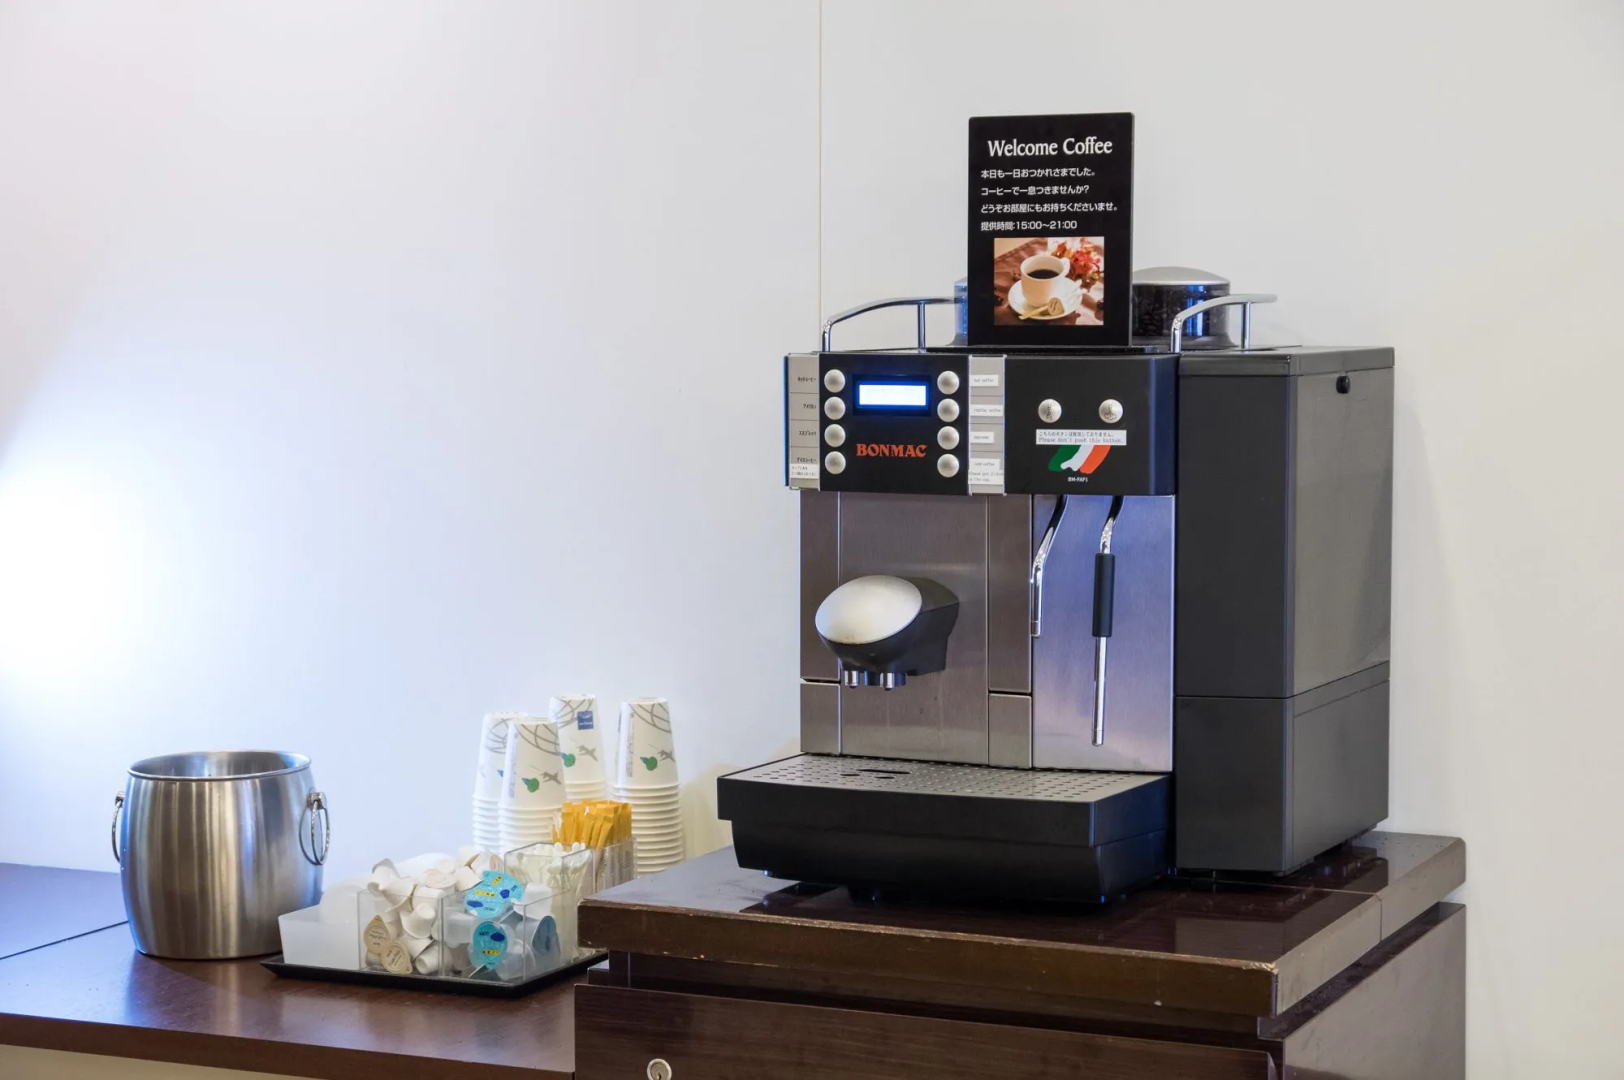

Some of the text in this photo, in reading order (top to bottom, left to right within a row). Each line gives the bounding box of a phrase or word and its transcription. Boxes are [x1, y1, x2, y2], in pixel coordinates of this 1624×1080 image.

[987, 136, 1113, 157] Welcome Coffee
[981, 167, 1096, 179] 本日も一日おつかれさまでした。
[981, 202, 1118, 214] どうぞお部屋にもお持ちくださいませ。
[856, 443, 928, 458] BONMAC
